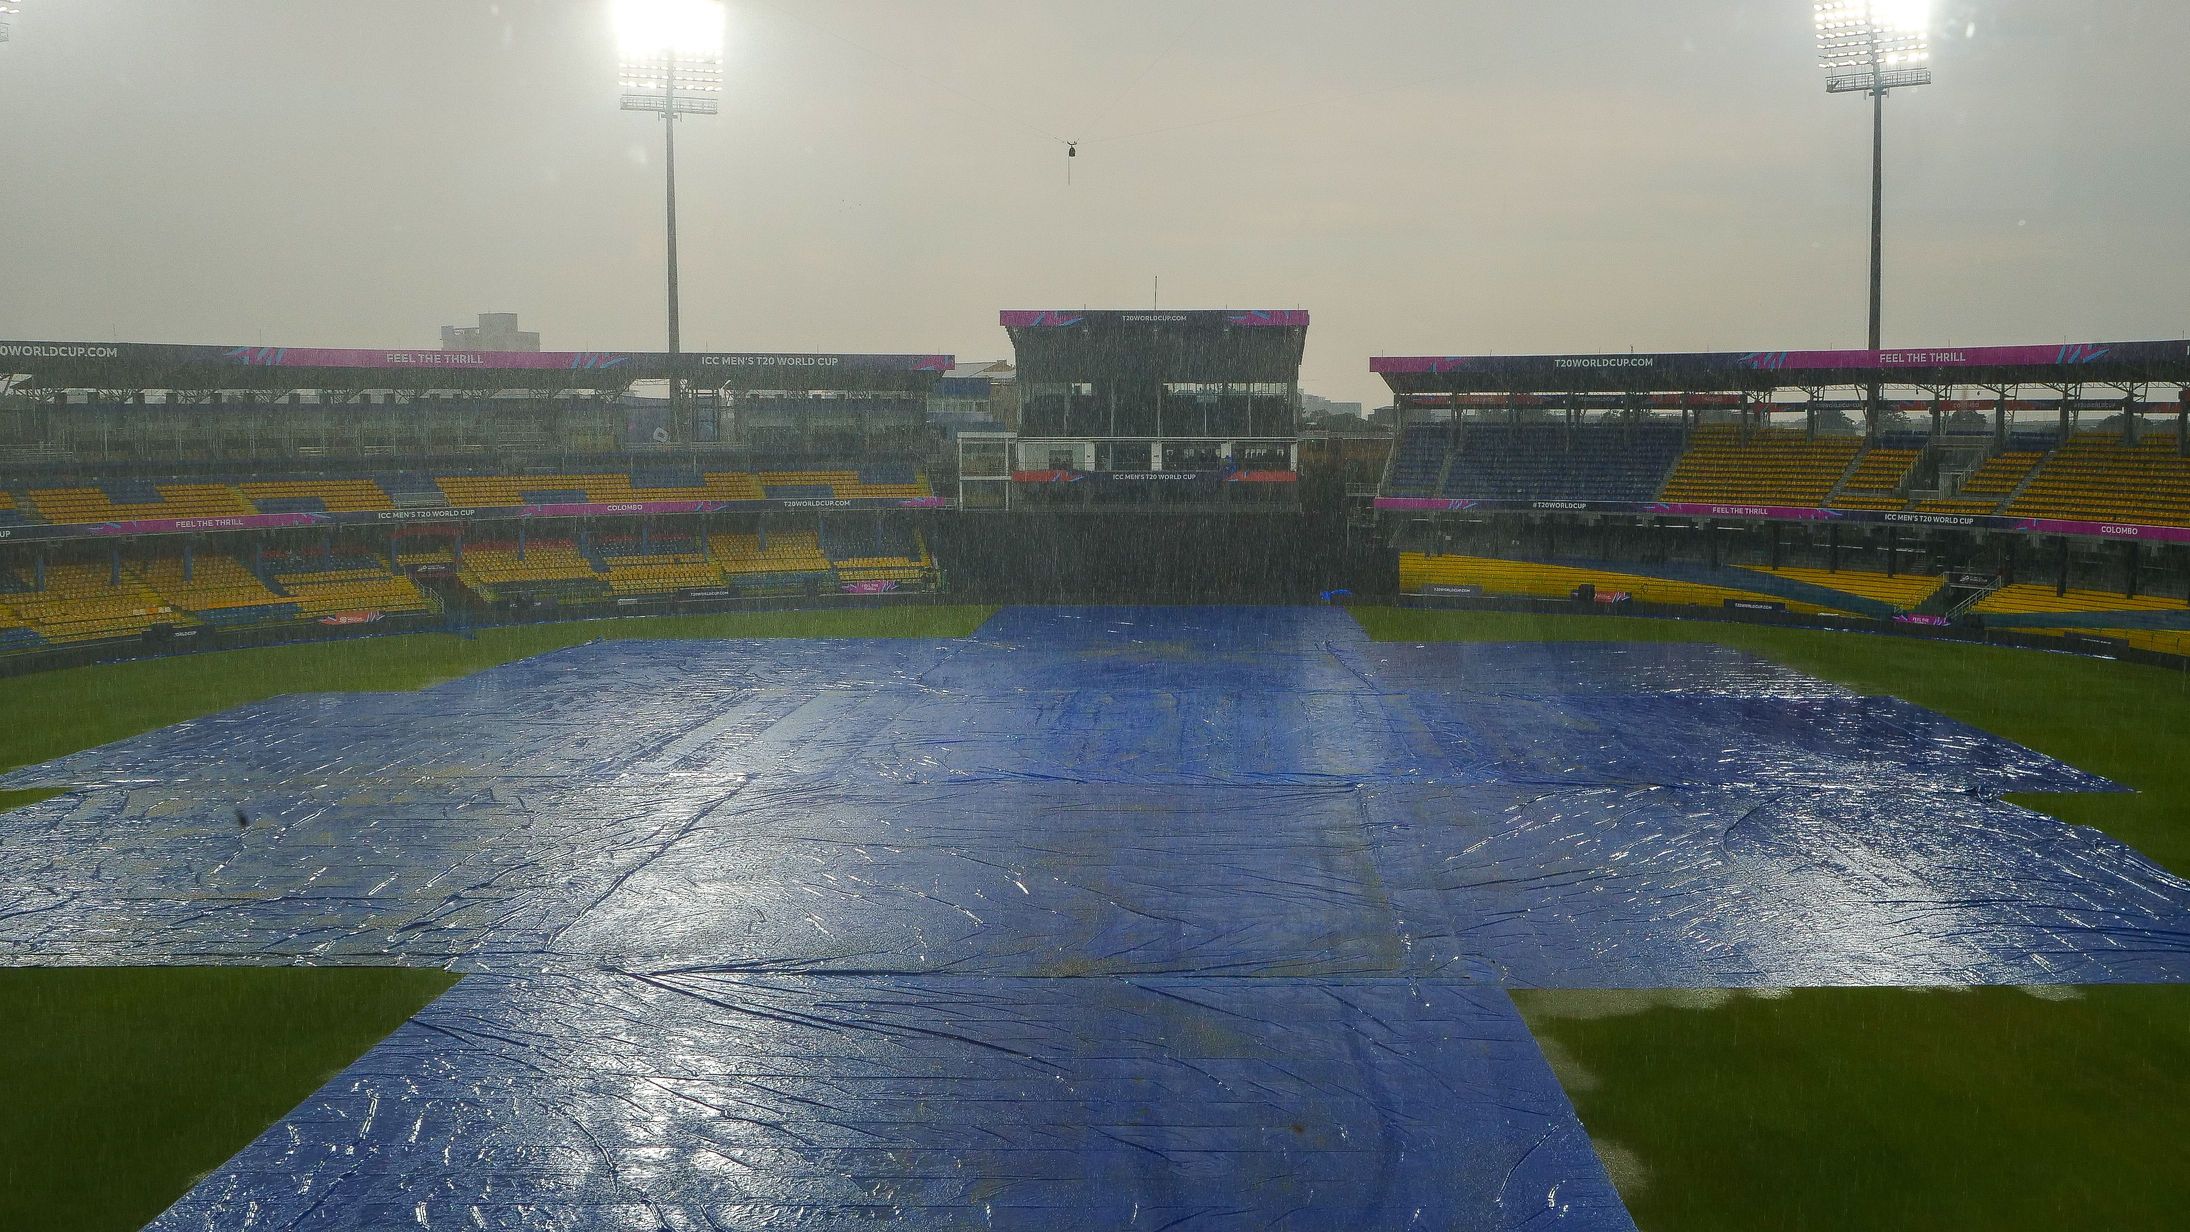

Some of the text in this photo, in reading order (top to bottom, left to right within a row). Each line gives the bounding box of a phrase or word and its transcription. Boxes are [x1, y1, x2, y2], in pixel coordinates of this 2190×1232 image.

[386, 354, 484, 364] FEEL THE THRILL
[701, 356, 839, 366] ICC MEN'S T20 WORLD CUP
[1880, 352, 1966, 363] FEEL THE THRILL
[1554, 358, 1653, 367] T20WORLDCUP.COM
[607, 504, 642, 512] COLOMBO
[393, 511, 416, 519] MEN'S
[1898, 514, 1918, 522] MEN'S
[1959, 517, 1974, 525] CUP
[175, 520, 196, 528] FEEL
[215, 519, 244, 527] THRILL
[2101, 526, 2138, 535] COLOMBO
